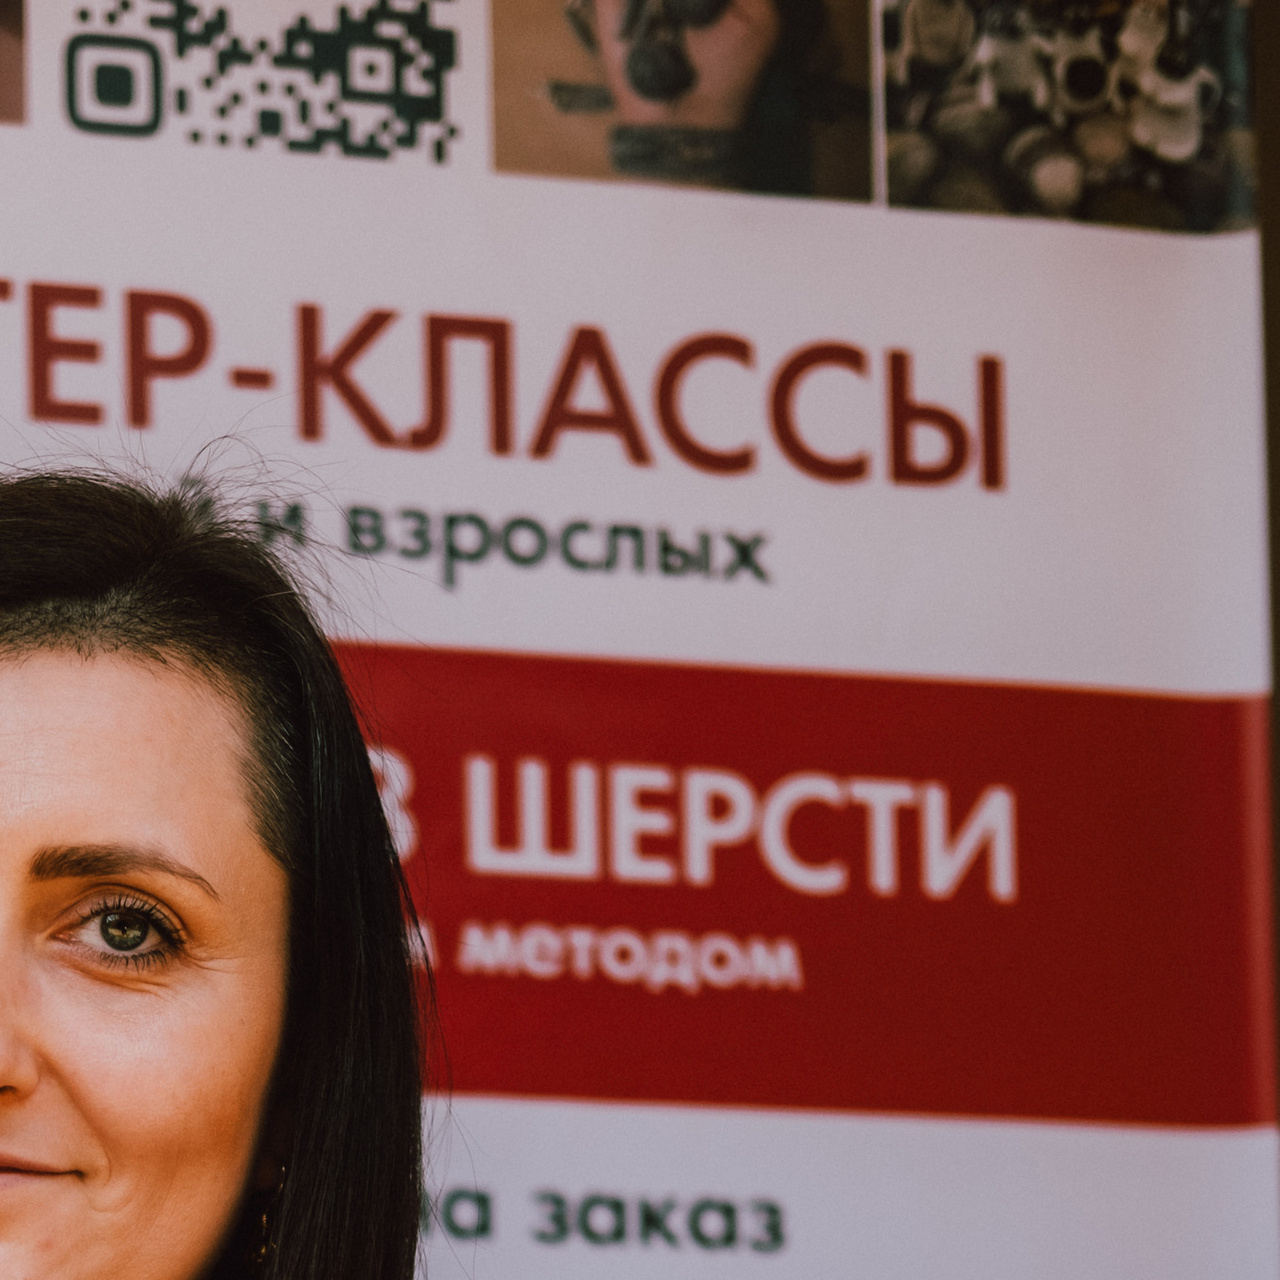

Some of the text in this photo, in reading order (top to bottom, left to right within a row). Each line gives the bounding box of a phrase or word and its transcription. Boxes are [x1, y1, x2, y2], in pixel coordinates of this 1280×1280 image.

[346, 501, 772, 590] взрослых
[465, 752, 1019, 904] ШЕРСТИ
[458, 919, 806, 996] методом
[421, 1188, 788, 1254] а заказ
